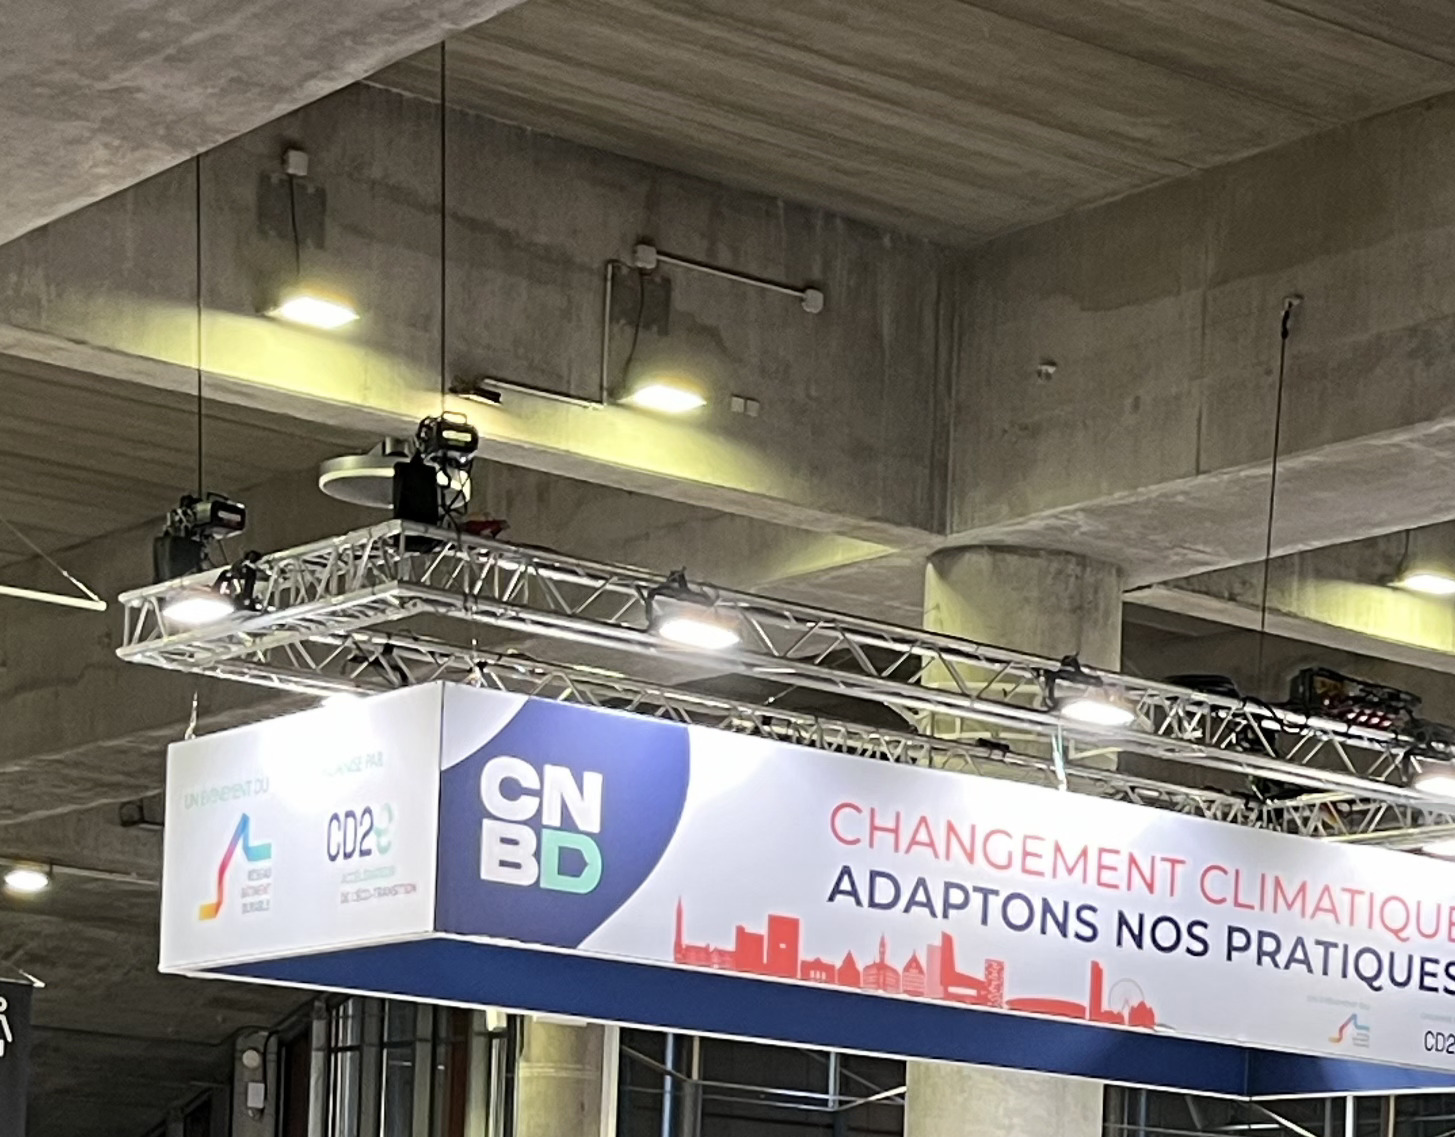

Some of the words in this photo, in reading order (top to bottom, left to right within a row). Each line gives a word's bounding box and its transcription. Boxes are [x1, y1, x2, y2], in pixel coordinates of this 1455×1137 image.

[480, 756, 604, 834] CN
[480, 818, 603, 895] BD
[830, 801, 1186, 898] CHANGEMENT
[826, 864, 1100, 944] ADAPTONS
[1116, 909, 1210, 958] NOS
